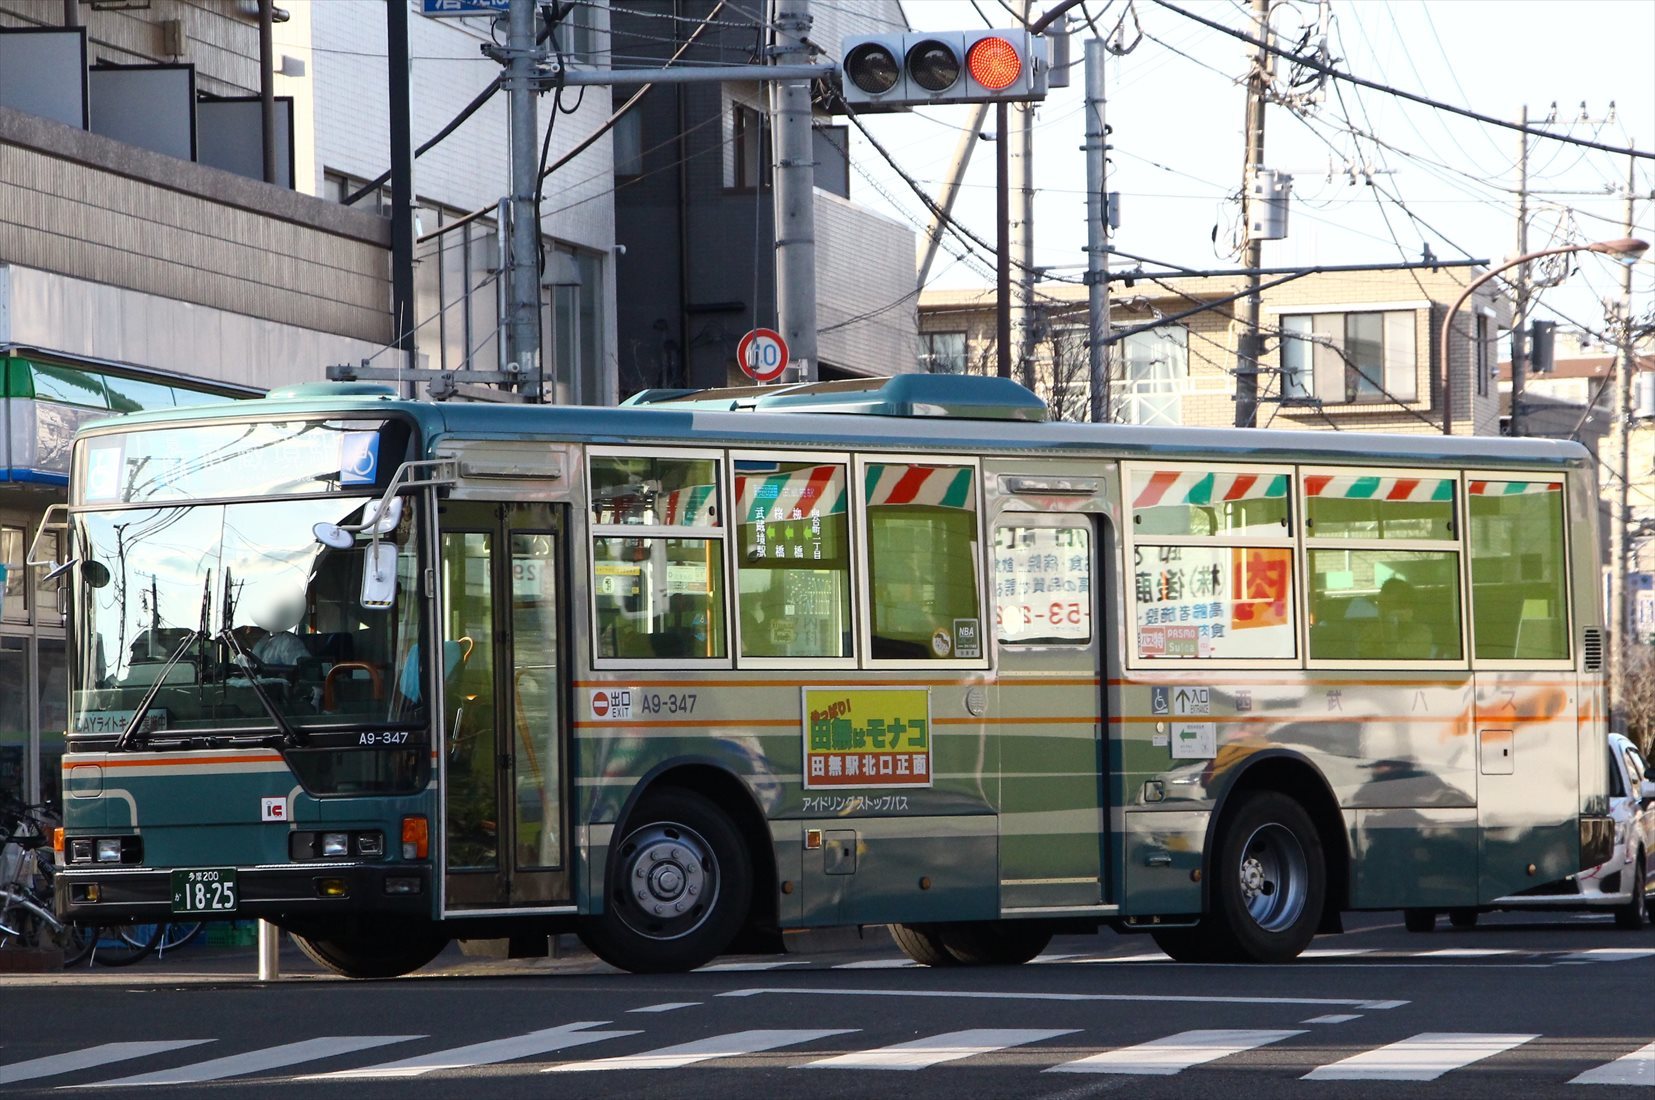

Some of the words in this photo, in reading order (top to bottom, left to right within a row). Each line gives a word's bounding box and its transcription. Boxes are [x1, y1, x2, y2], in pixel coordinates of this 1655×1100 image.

[959, 627, 974, 637] NBA
[1167, 629, 1195, 639] PASMO
[1168, 642, 1195, 652] Suica
[611, 692, 631, 706] 出口
[642, 694, 697, 713] A9-347
[1191, 689, 1208, 704] 入口
[612, 707, 629, 717] EXIT
[359, 732, 408, 744] A9-347
[810, 717, 926, 751] 田無はモナコ
[811, 754, 927, 776] 田無駅北口正面
[174, 893, 182, 902] か
[185, 881, 234, 910] 18-25
